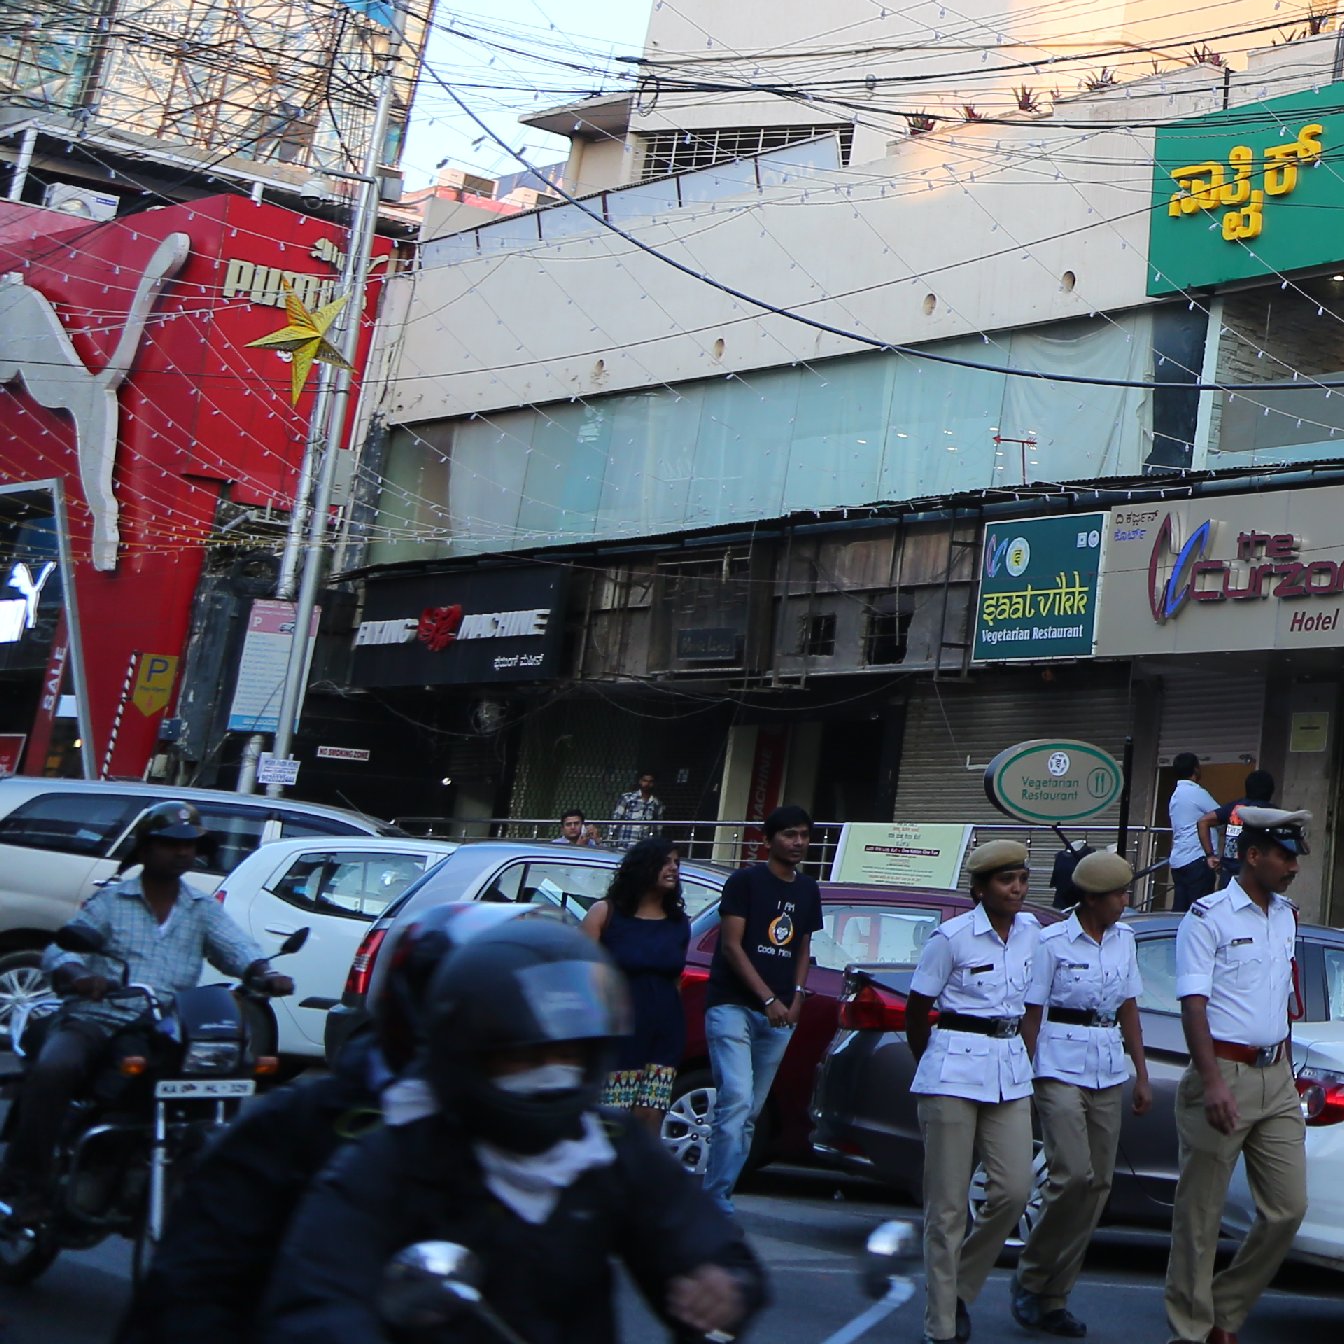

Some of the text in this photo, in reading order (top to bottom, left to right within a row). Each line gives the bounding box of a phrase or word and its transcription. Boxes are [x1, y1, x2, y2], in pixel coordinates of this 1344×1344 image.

[1237, 529, 1296, 561] the
[456, 608, 551, 640] MACHINE
[1289, 608, 1340, 633] Hotel
[982, 625, 1083, 644] Vegetarian Restaurant
[147, 658, 168, 682] P
[1021, 776, 1079, 788] Vegetarian
[1021, 789, 1078, 800] Restaurant
